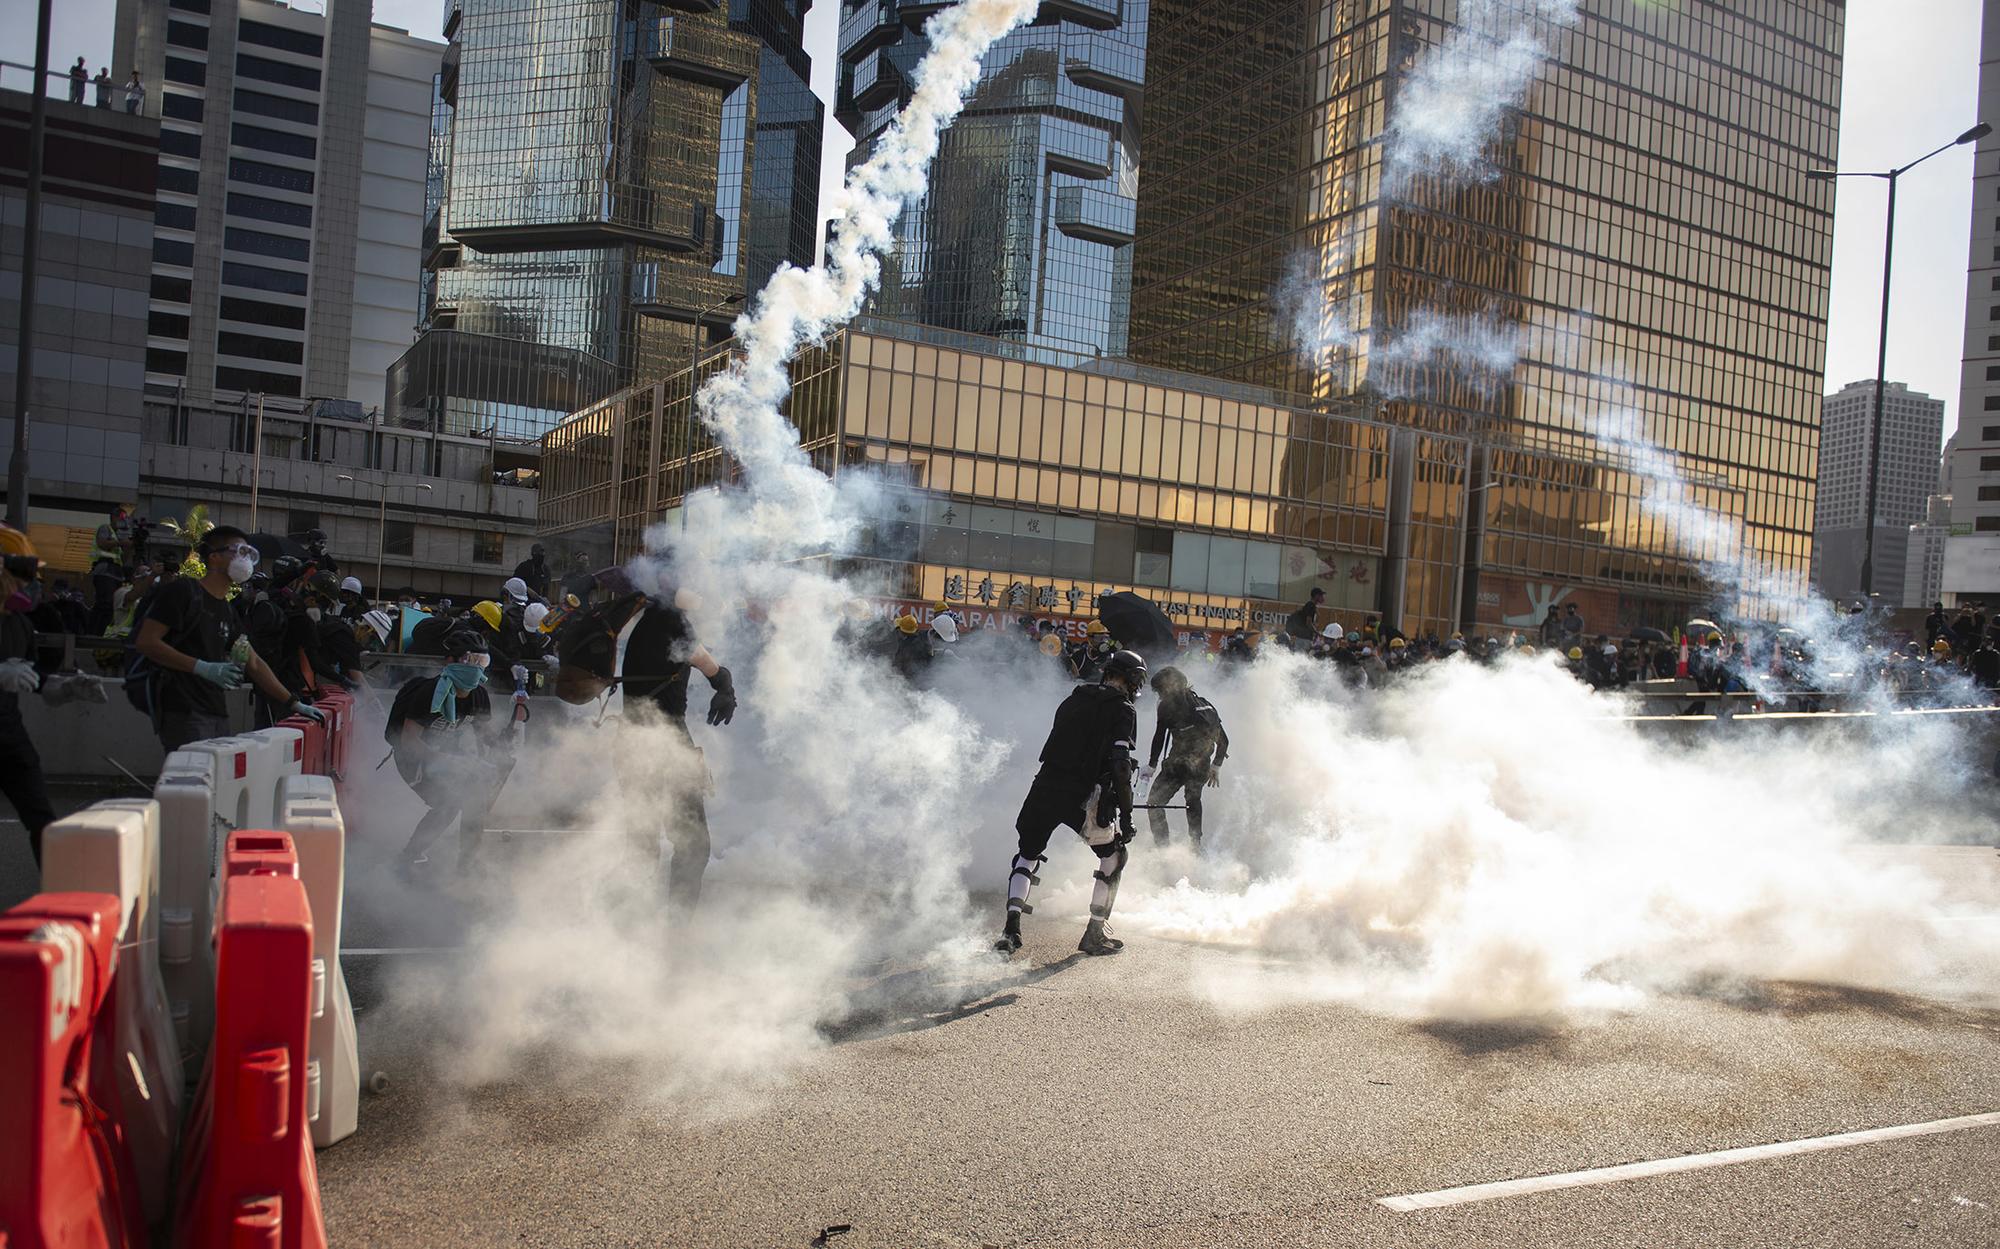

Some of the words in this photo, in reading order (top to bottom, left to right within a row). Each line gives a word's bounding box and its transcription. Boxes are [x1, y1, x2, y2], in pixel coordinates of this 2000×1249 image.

[911, 606, 998, 630] NEARA
[1160, 601, 1193, 616] EAST
[1198, 605, 1248, 621] FINANCE
